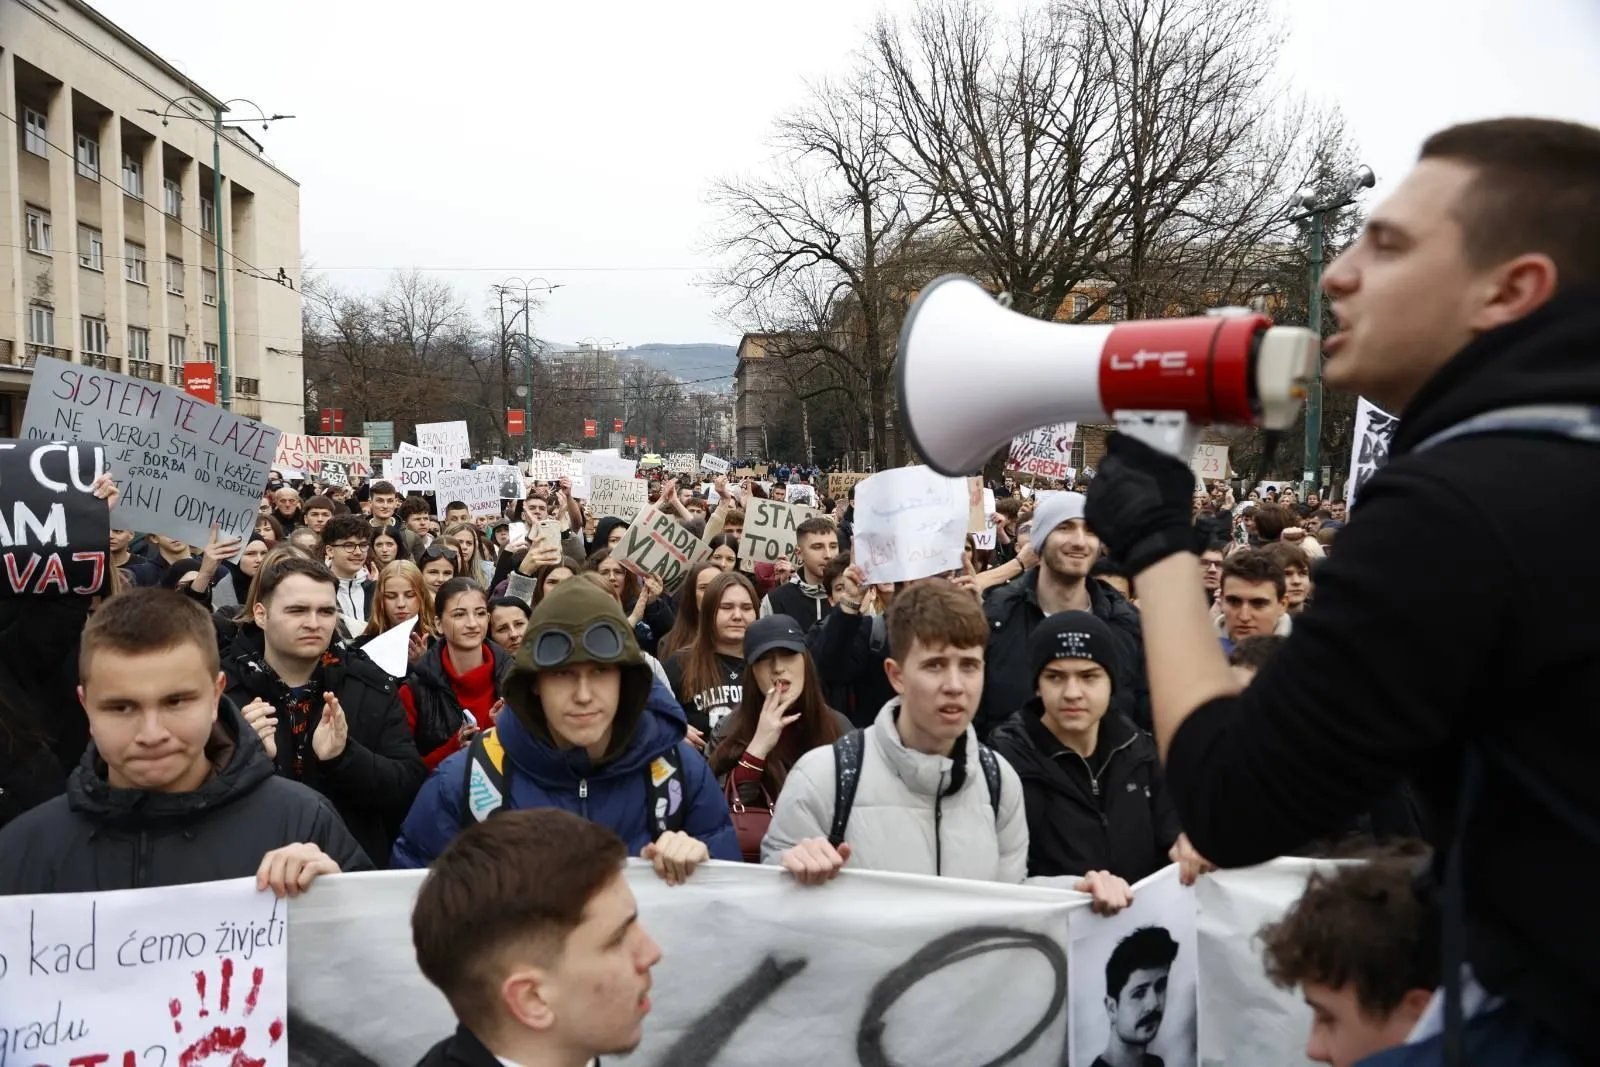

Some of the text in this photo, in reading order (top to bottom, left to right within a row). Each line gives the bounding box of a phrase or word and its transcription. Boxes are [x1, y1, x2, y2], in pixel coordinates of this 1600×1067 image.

[52, 370, 276, 465] SISTEM TE LAŽE
[54, 407, 263, 486] NE VJERUJ ŠTA TI KAŽE
[305, 436, 363, 454] NEMAR
[115, 448, 136, 462] JE
[143, 451, 186, 474] BORBA
[194, 467, 211, 483] OD
[128, 466, 168, 481] GROBA
[401, 470, 432, 485] BORI
[402, 456, 434, 469] IZADI
[1201, 458, 1219, 472] 23
[594, 478, 644, 491] UBIJATE
[754, 500, 797, 532] ŠTA
[652, 514, 697, 561] PADA
[3, 551, 105, 595] VAJ
[29, 900, 97, 977] kad
[116, 929, 207, 968] ćemo
[215, 895, 285, 960] živjeti
